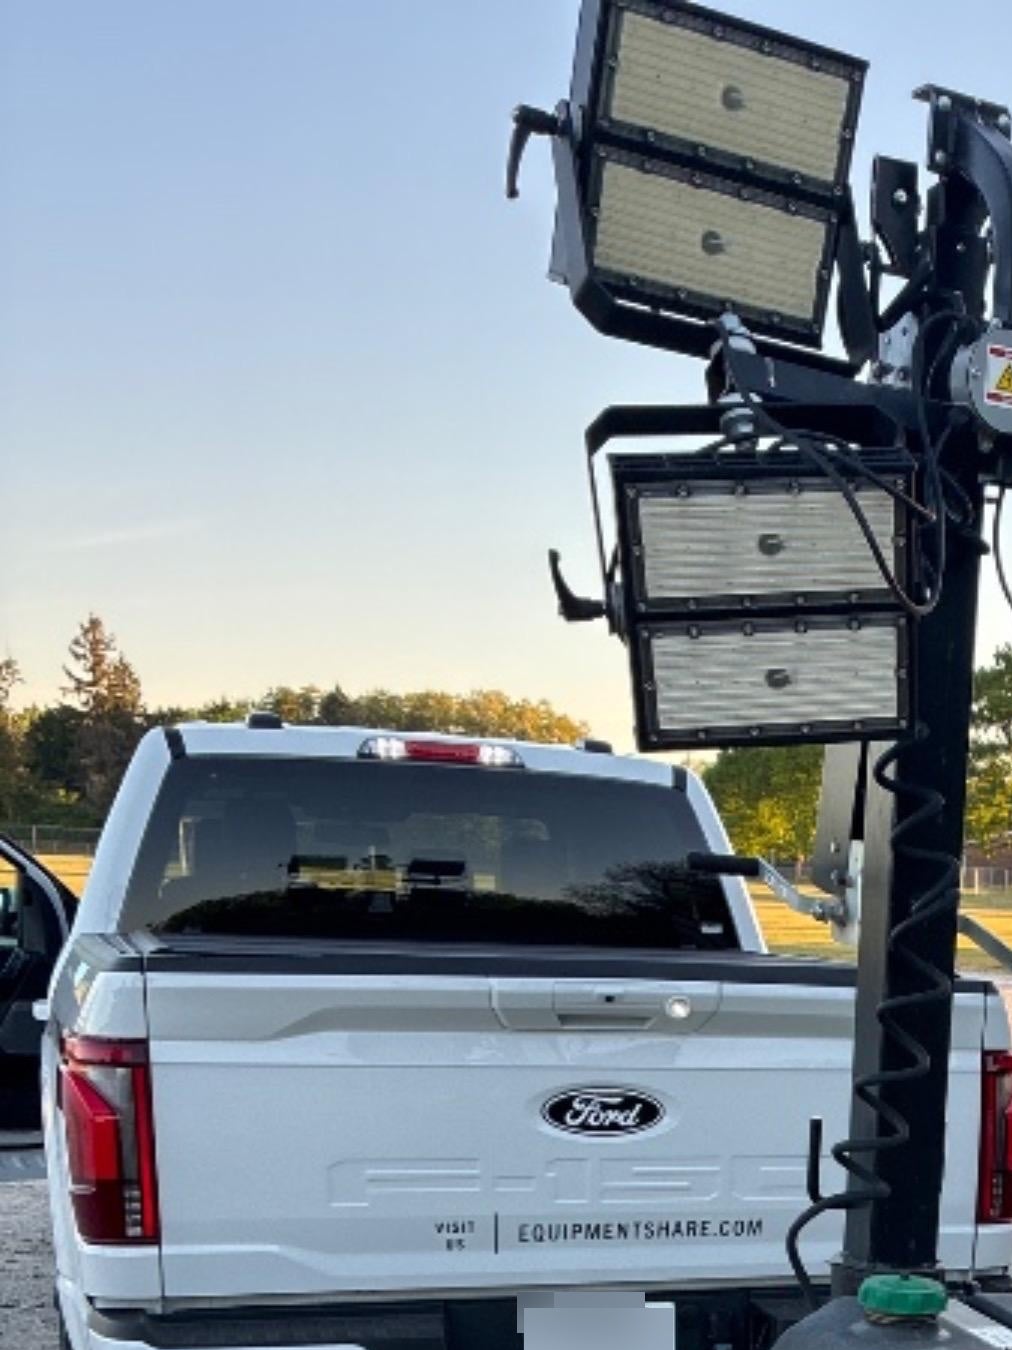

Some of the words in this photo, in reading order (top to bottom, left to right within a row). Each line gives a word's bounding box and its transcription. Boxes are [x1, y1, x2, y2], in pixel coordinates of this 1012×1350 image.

[565, 1095, 643, 1126] Ford
[434, 1220, 476, 1235] VISIT
[517, 1219, 763, 1243] EQUIPMENTSHARE.COM
